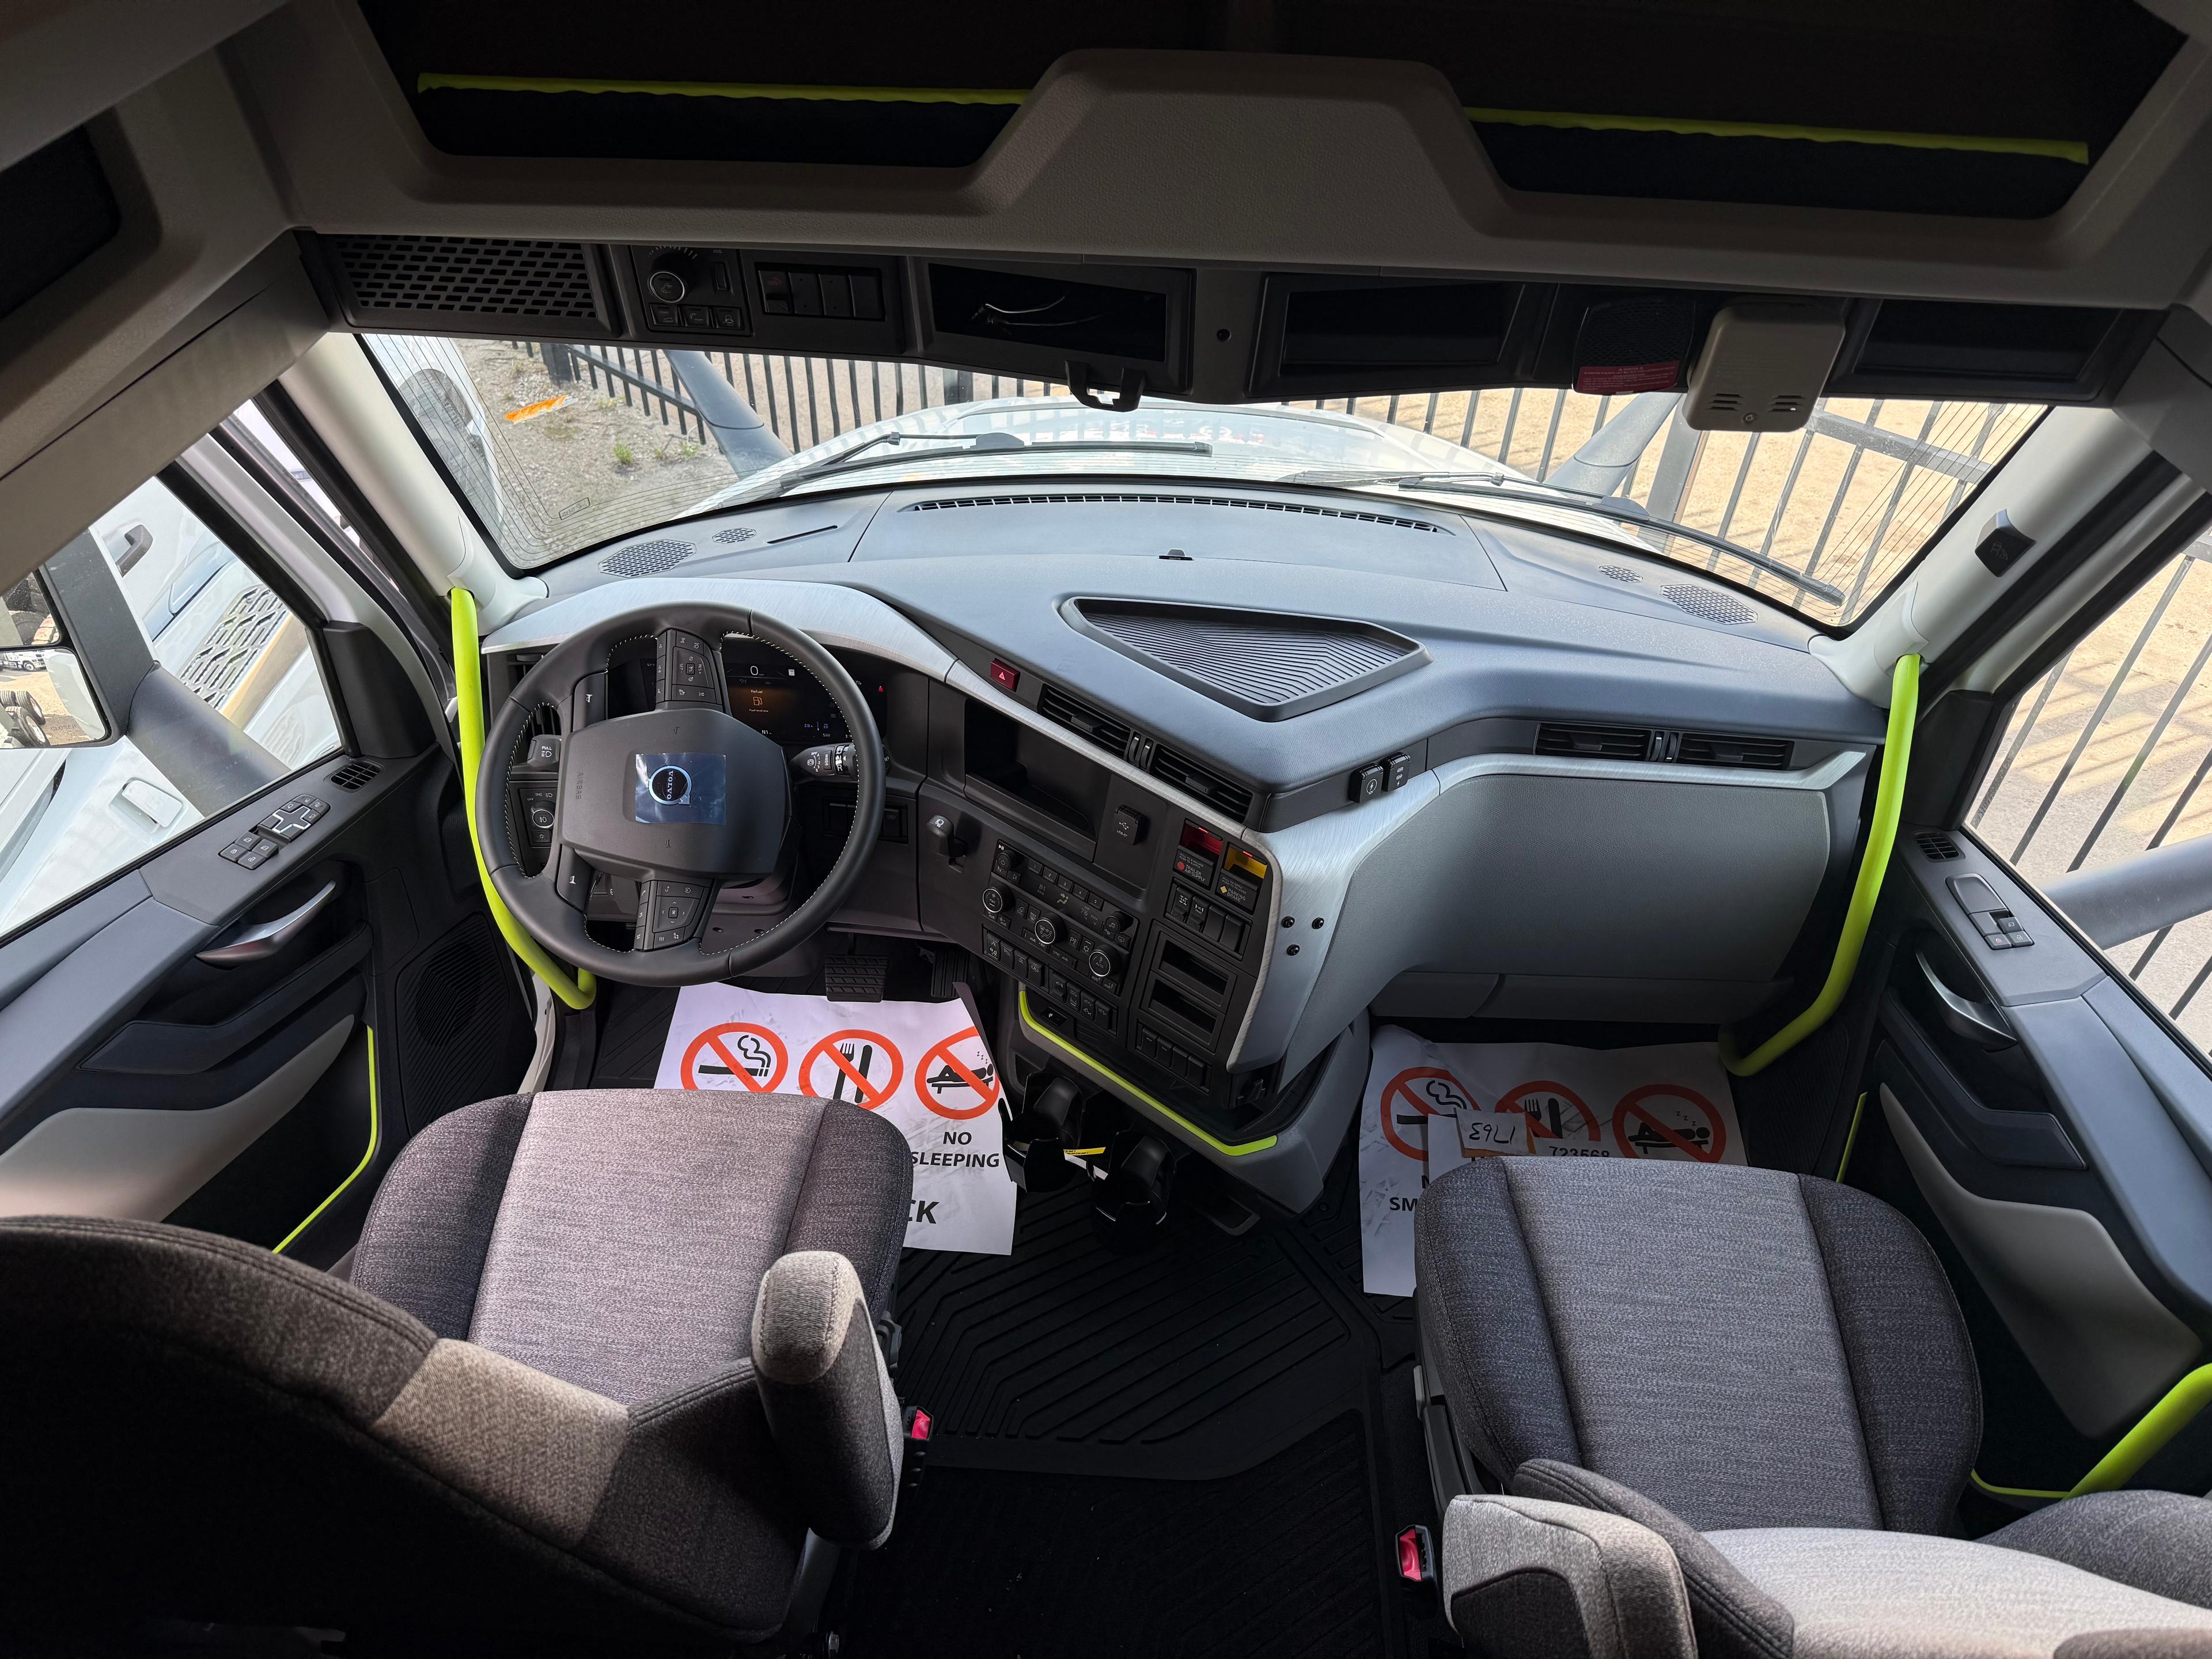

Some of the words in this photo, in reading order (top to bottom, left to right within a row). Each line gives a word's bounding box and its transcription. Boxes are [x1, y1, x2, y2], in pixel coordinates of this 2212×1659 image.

[750, 665, 758, 676] 0
[1185, 864, 1202, 876] TRAILER
[1191, 871, 1205, 882] SUPPLY
[1227, 892, 1241, 903] BRAKE
[1228, 888, 1246, 901] PARKING
[943, 1131, 972, 1145] NO
[911, 1152, 999, 1168] SLEEPING
